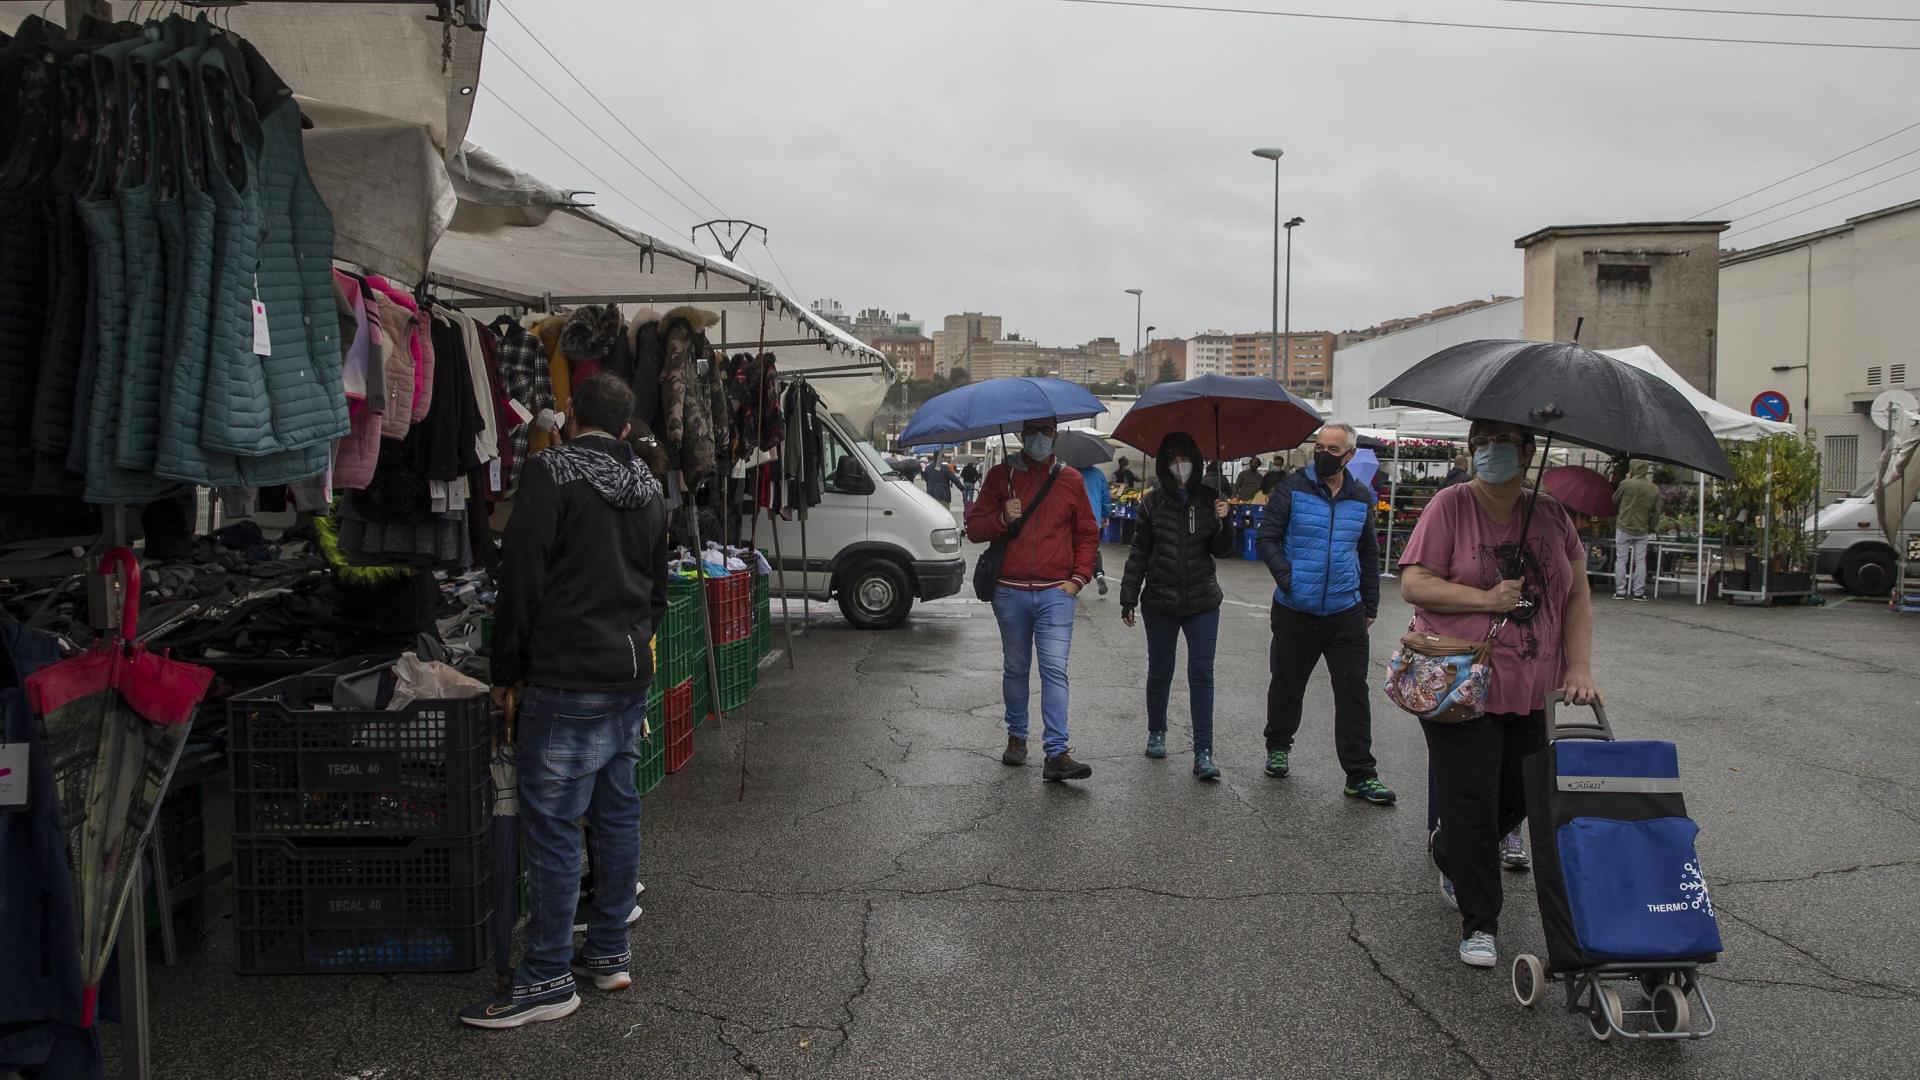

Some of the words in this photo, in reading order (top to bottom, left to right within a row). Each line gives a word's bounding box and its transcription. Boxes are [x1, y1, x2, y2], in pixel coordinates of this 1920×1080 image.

[327, 763, 364, 775] TECAL
[368, 763, 381, 775] 40
[328, 900, 365, 912] TECAL
[369, 899, 382, 911] 40
[1646, 902, 1688, 913] THERMO
